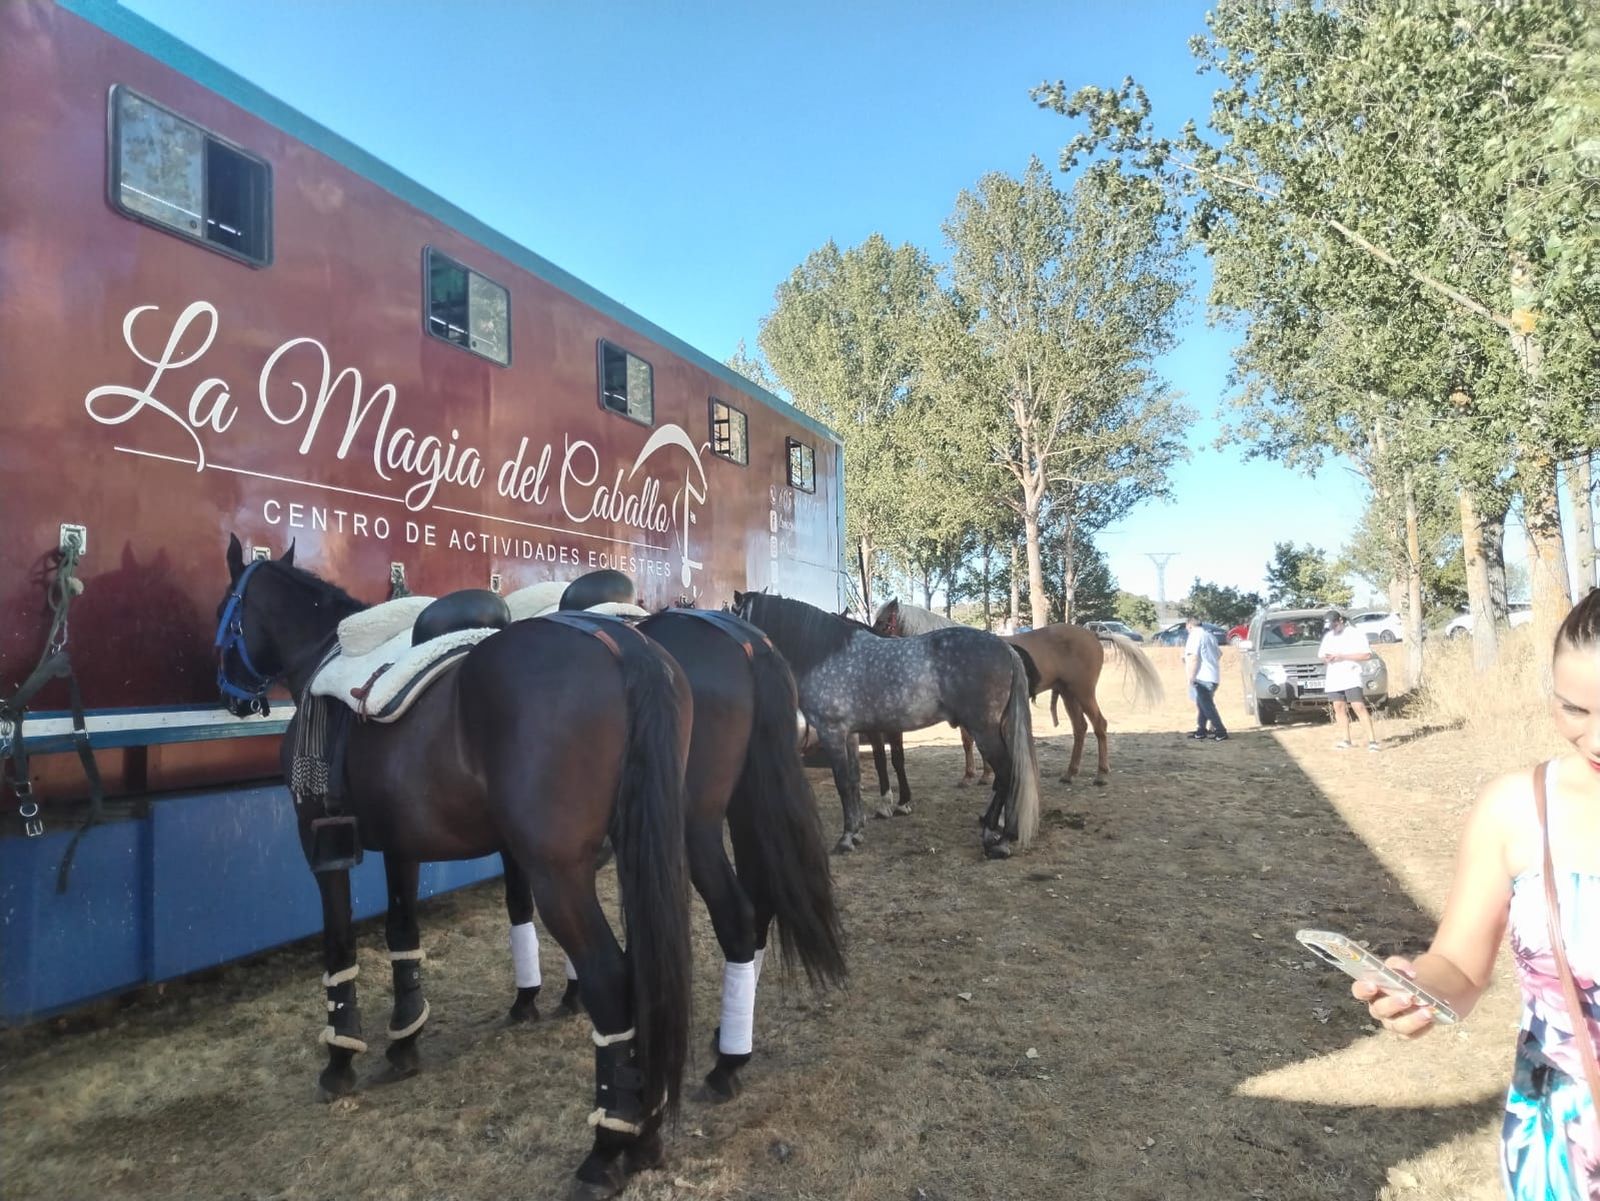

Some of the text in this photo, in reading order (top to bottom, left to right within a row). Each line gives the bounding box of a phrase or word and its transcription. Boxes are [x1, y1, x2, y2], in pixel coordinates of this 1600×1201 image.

[85, 300, 671, 533] La Magia del Caballo
[263, 500, 671, 577] CENTRO DE ACTIVIDADES ECUESTRES
